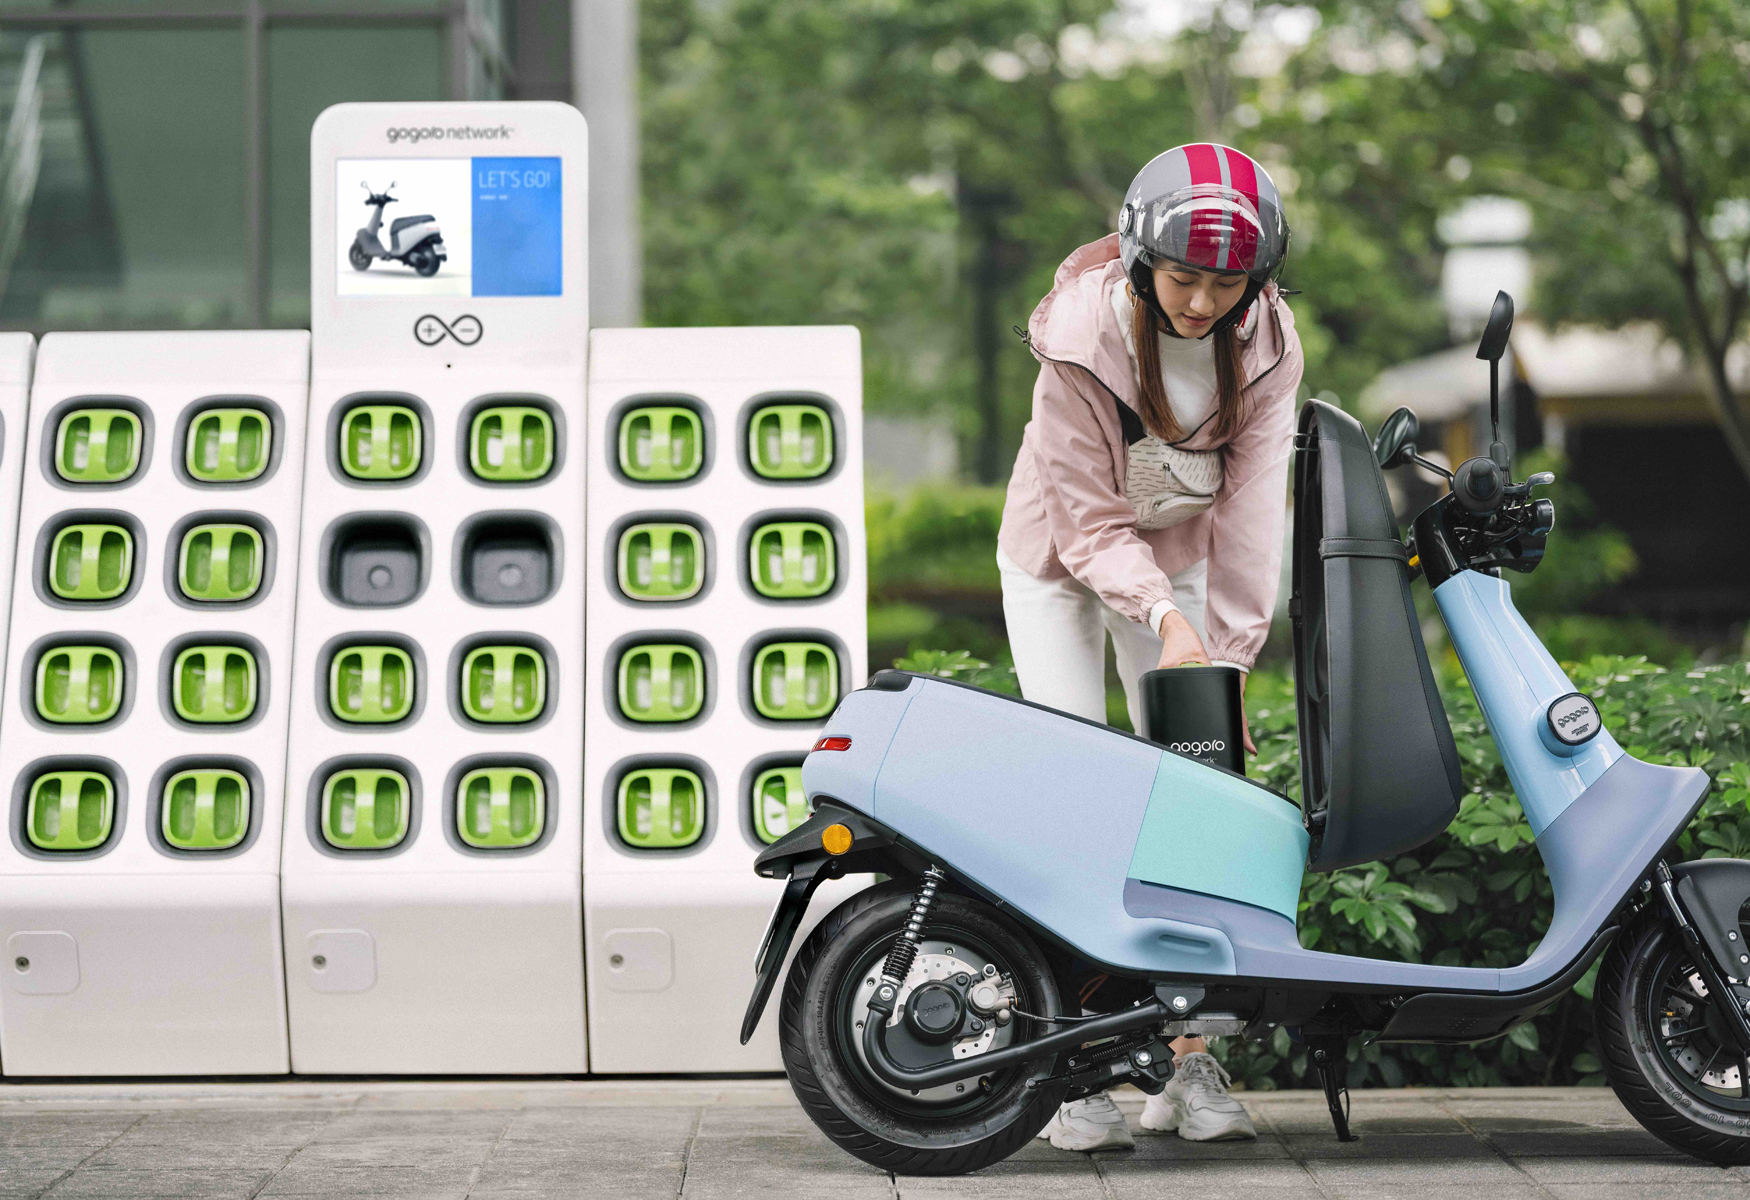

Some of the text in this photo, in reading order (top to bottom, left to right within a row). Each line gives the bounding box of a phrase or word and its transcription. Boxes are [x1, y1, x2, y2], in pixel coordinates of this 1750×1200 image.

[386, 125, 511, 144] gogoro network
[478, 170, 551, 189] LET'S GO!
[922, 1002, 951, 1017] gogoro
